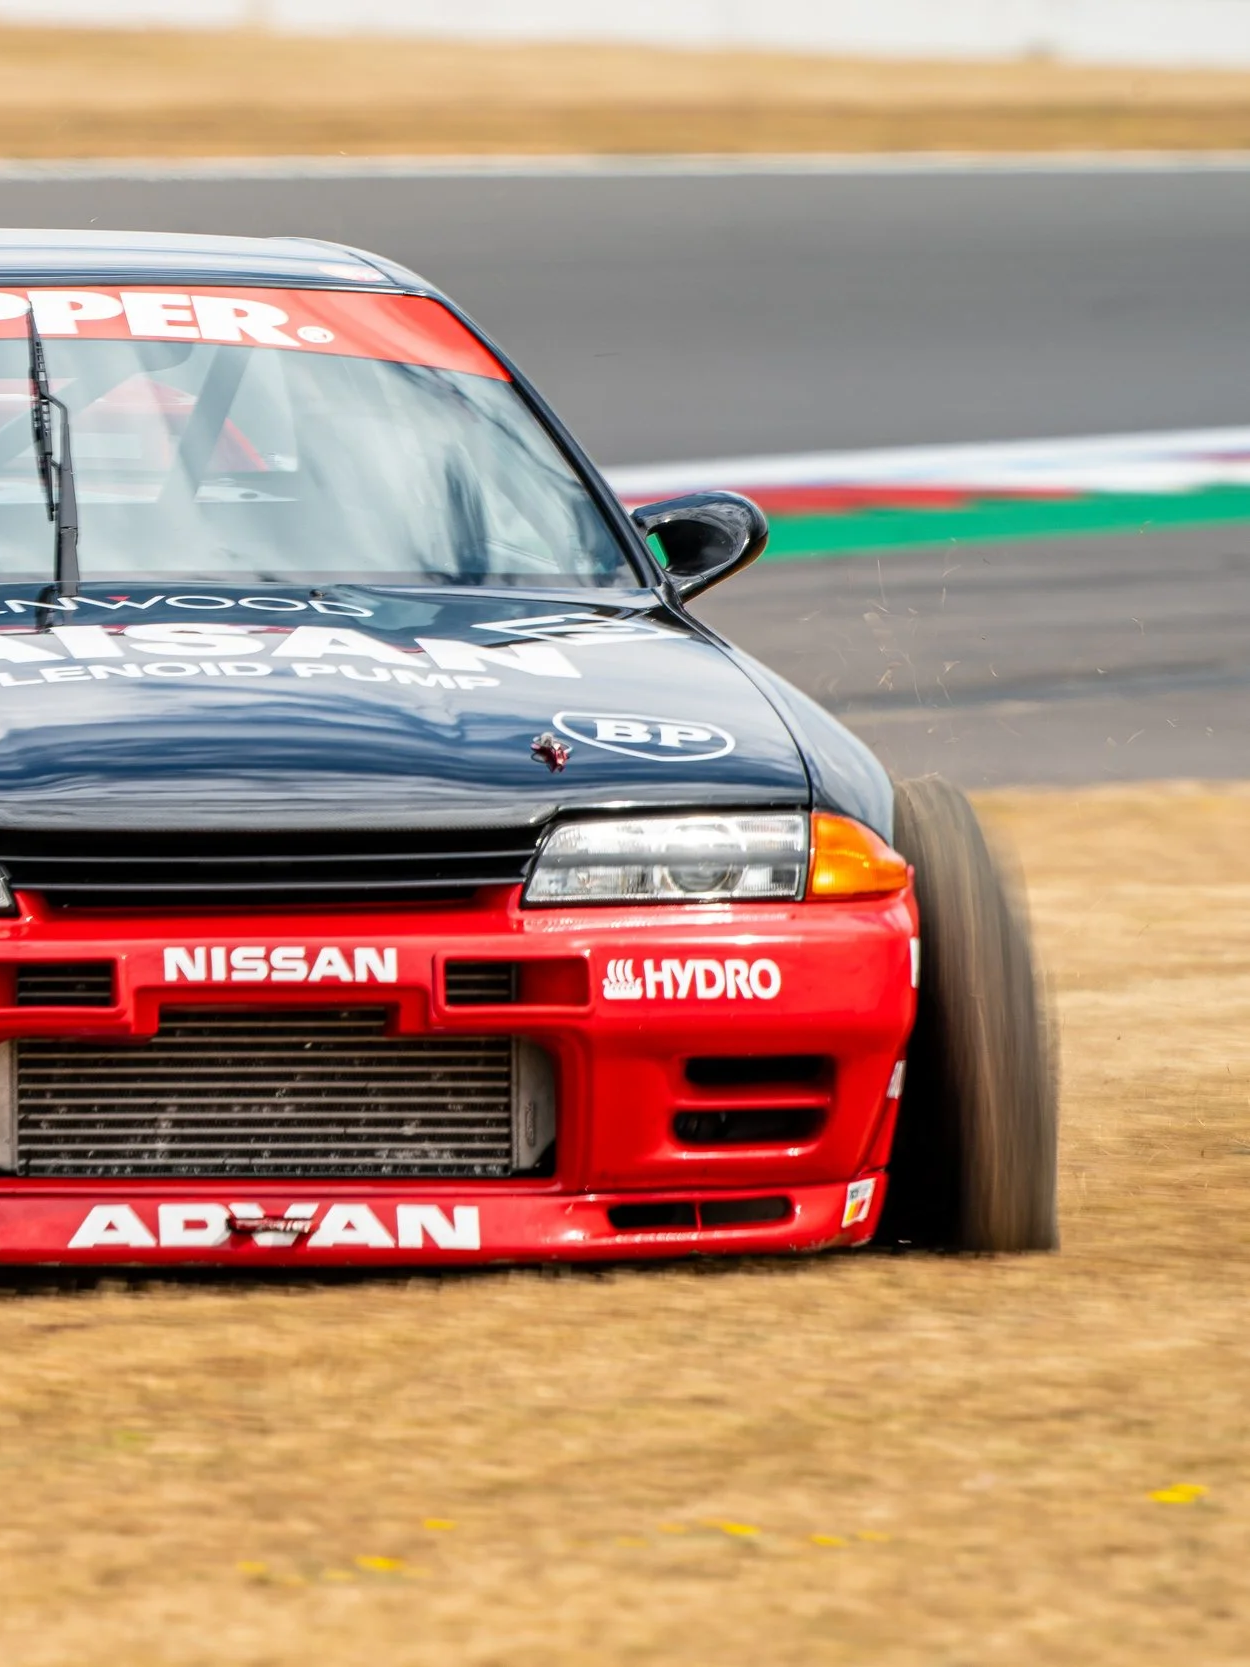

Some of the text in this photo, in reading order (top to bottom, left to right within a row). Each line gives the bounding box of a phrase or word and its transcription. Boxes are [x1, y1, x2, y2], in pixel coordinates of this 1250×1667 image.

[291, 663, 501, 690] PUMP
[593, 717, 712, 748] BP
[163, 946, 398, 983] NISSAN
[644, 958, 781, 1000] HYDRO
[67, 1202, 481, 1251] ADVAN
